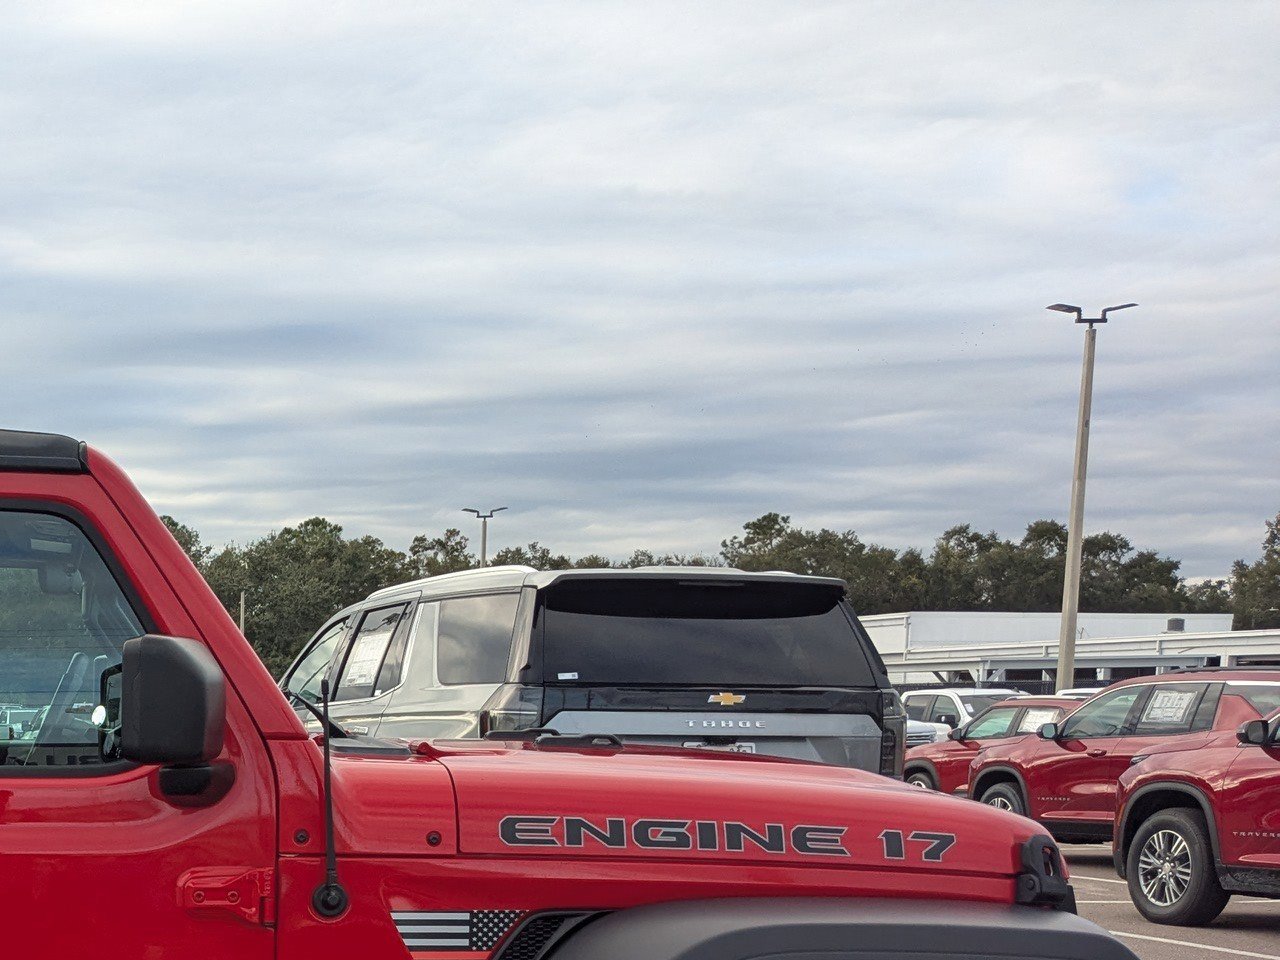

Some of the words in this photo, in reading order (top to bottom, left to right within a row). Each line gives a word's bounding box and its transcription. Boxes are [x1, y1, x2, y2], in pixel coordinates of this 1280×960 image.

[684, 719, 767, 729] TAHOE
[498, 815, 851, 858] ENGINE
[877, 829, 957, 862] 17
